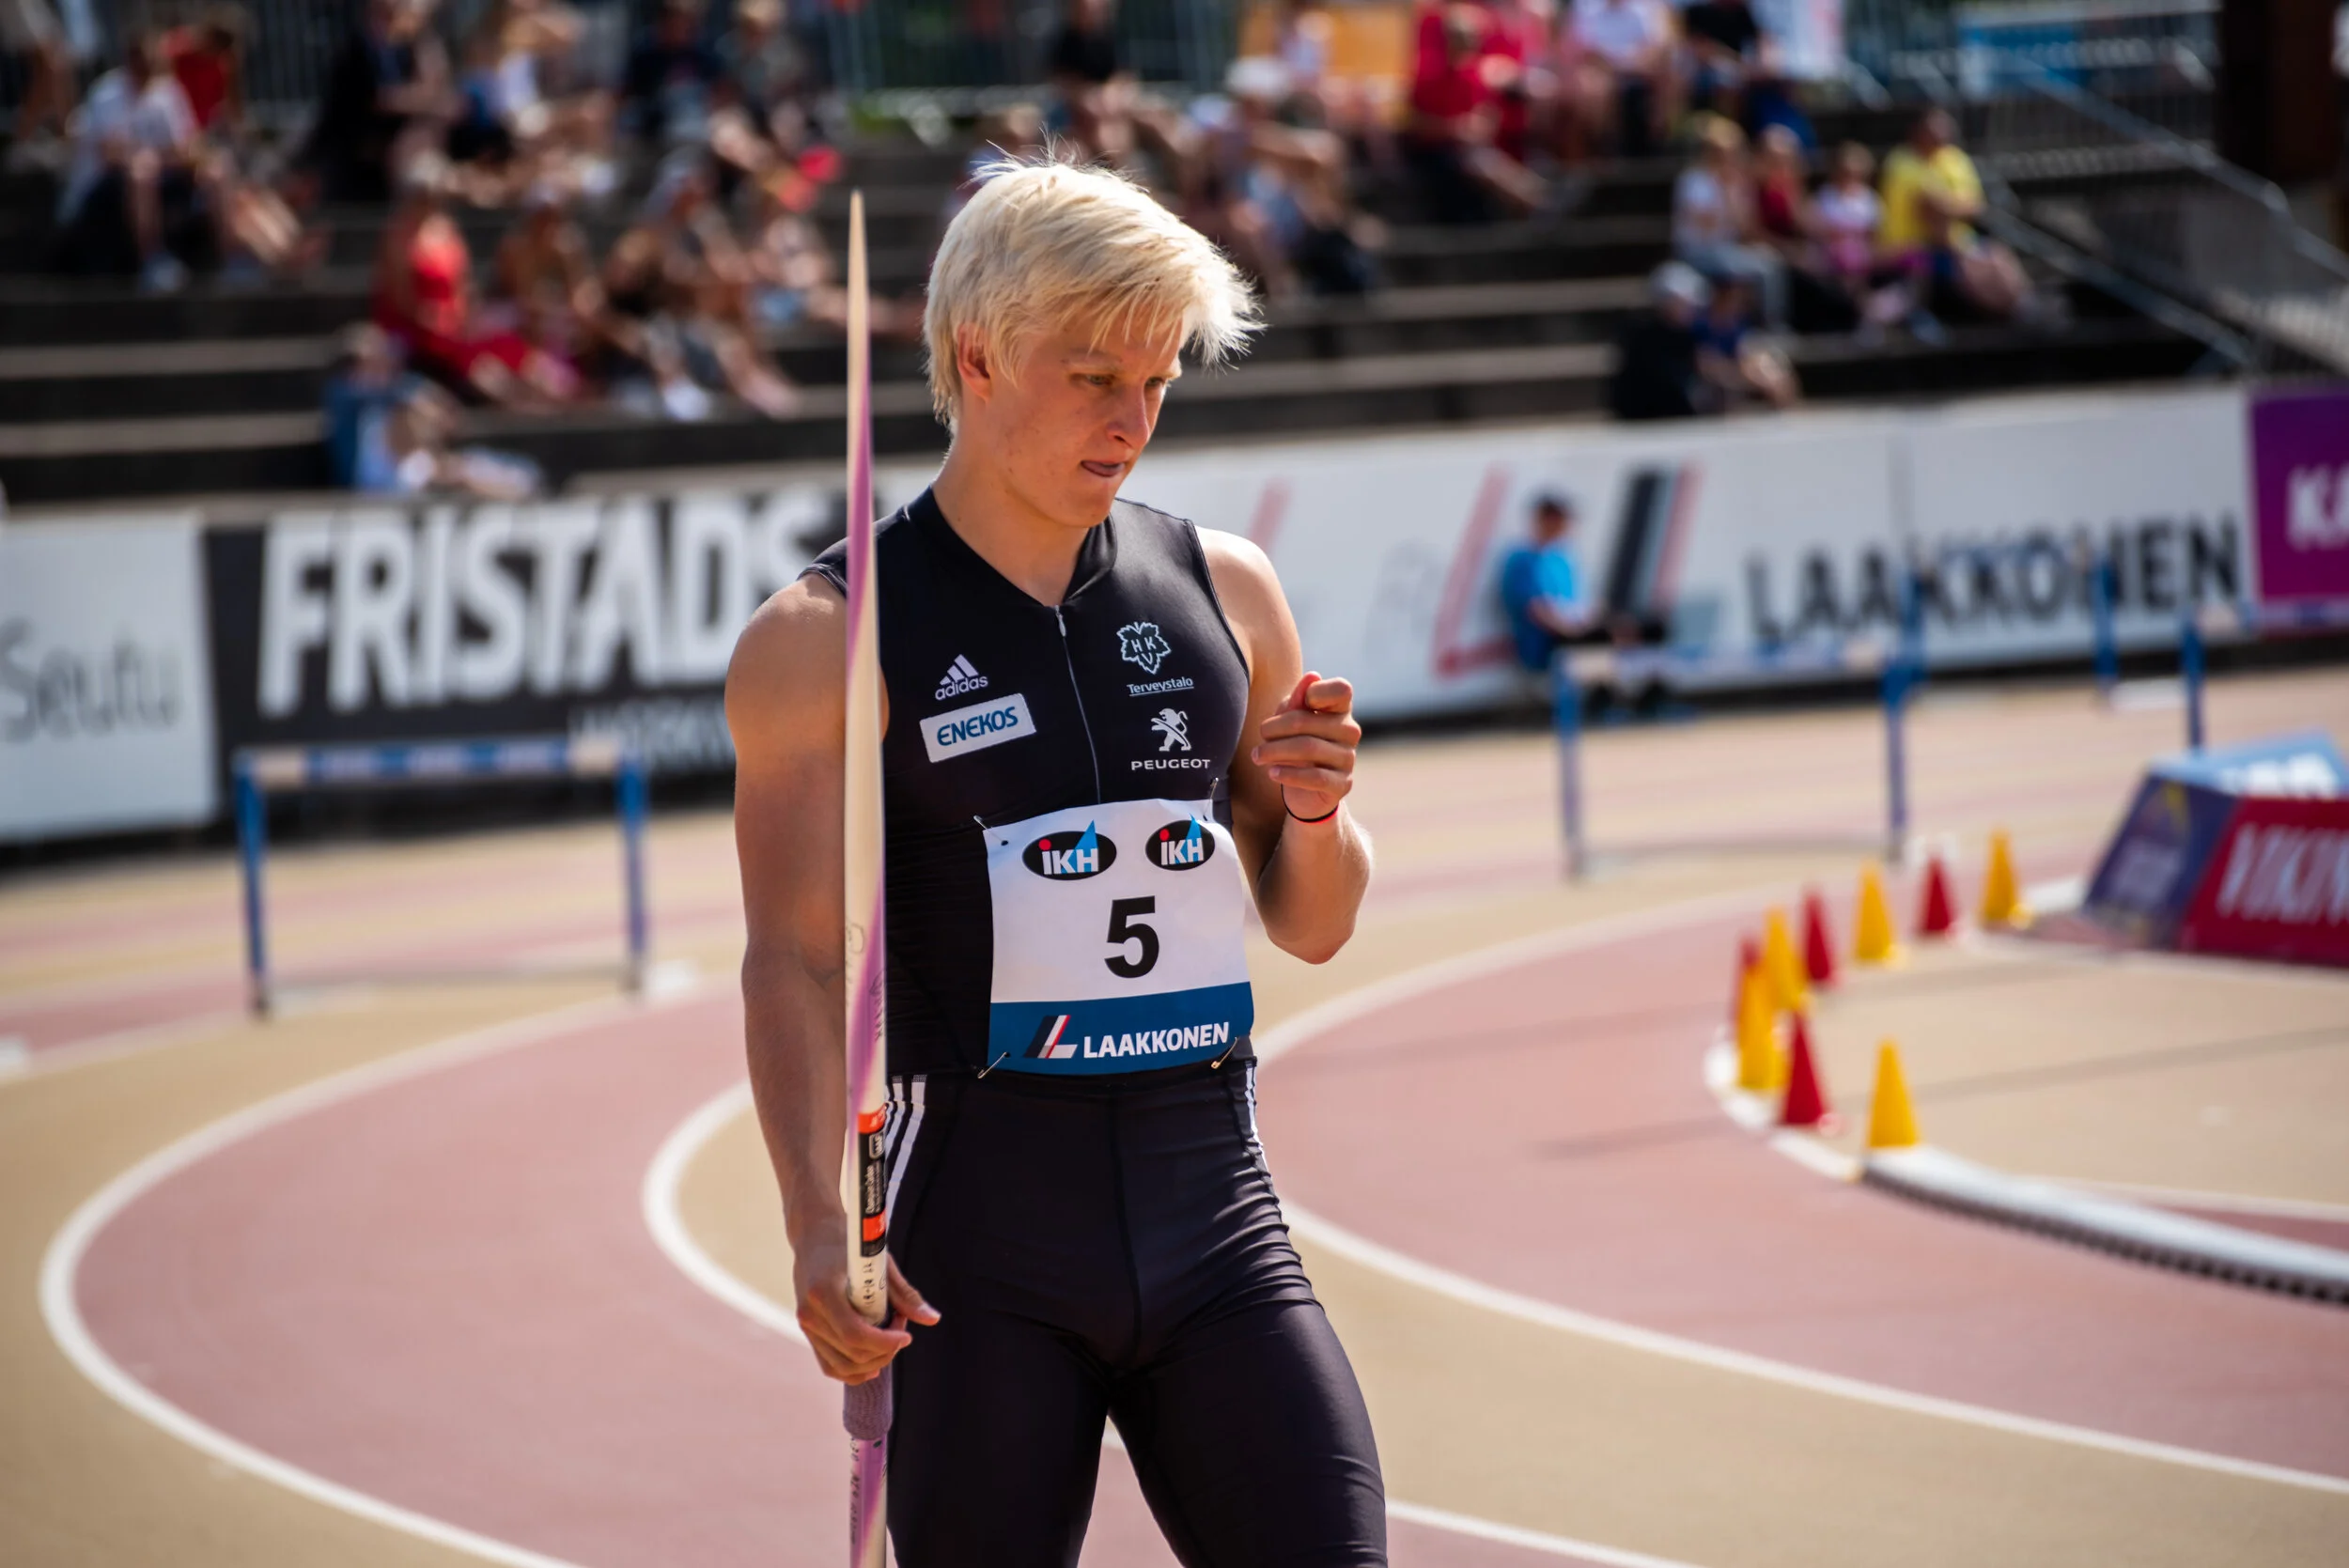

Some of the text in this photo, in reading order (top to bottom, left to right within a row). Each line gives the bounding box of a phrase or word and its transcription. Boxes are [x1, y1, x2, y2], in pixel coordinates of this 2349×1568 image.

[934, 675, 988, 701] adidas
[1127, 676, 1193, 694] Terveystalo
[937, 706, 1019, 747] ENEKOS
[1130, 758, 1211, 771] PEUGEOT
[1104, 894, 1160, 979] 5
[1083, 1022, 1230, 1059] LAAKKONEN
